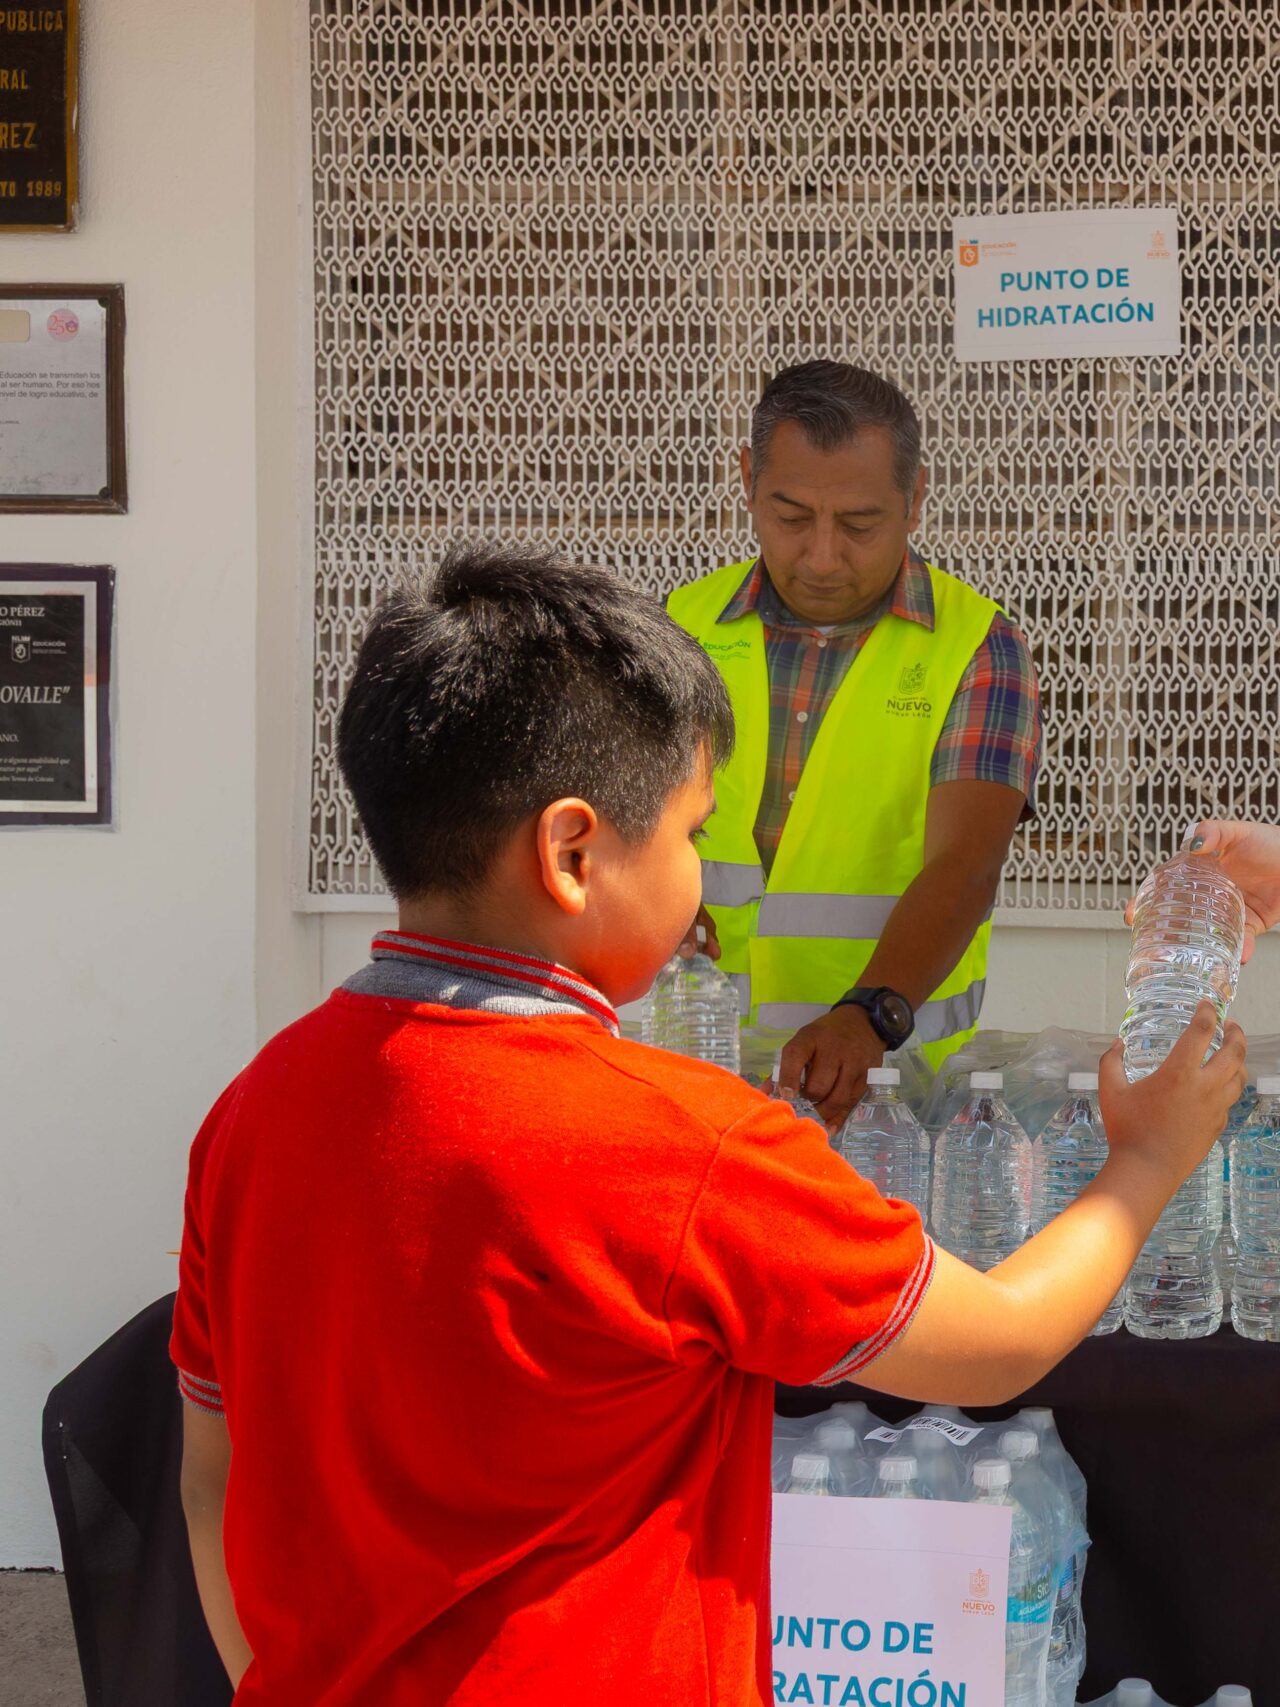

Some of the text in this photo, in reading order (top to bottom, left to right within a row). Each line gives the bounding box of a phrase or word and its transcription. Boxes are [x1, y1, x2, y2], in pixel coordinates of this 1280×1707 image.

[0, 69, 28, 89] RAL
[1000, 268, 1130, 292] PUNTO DE
[977, 297, 1154, 328] HIDRATACIÓN
[10, 604, 46, 617] PÉREZ
[887, 699, 932, 712] NUEVO
[962, 1601, 996, 1612] NUEVO
[883, 1621, 934, 1654] DE
[772, 1669, 966, 1707] RATACIÓN
